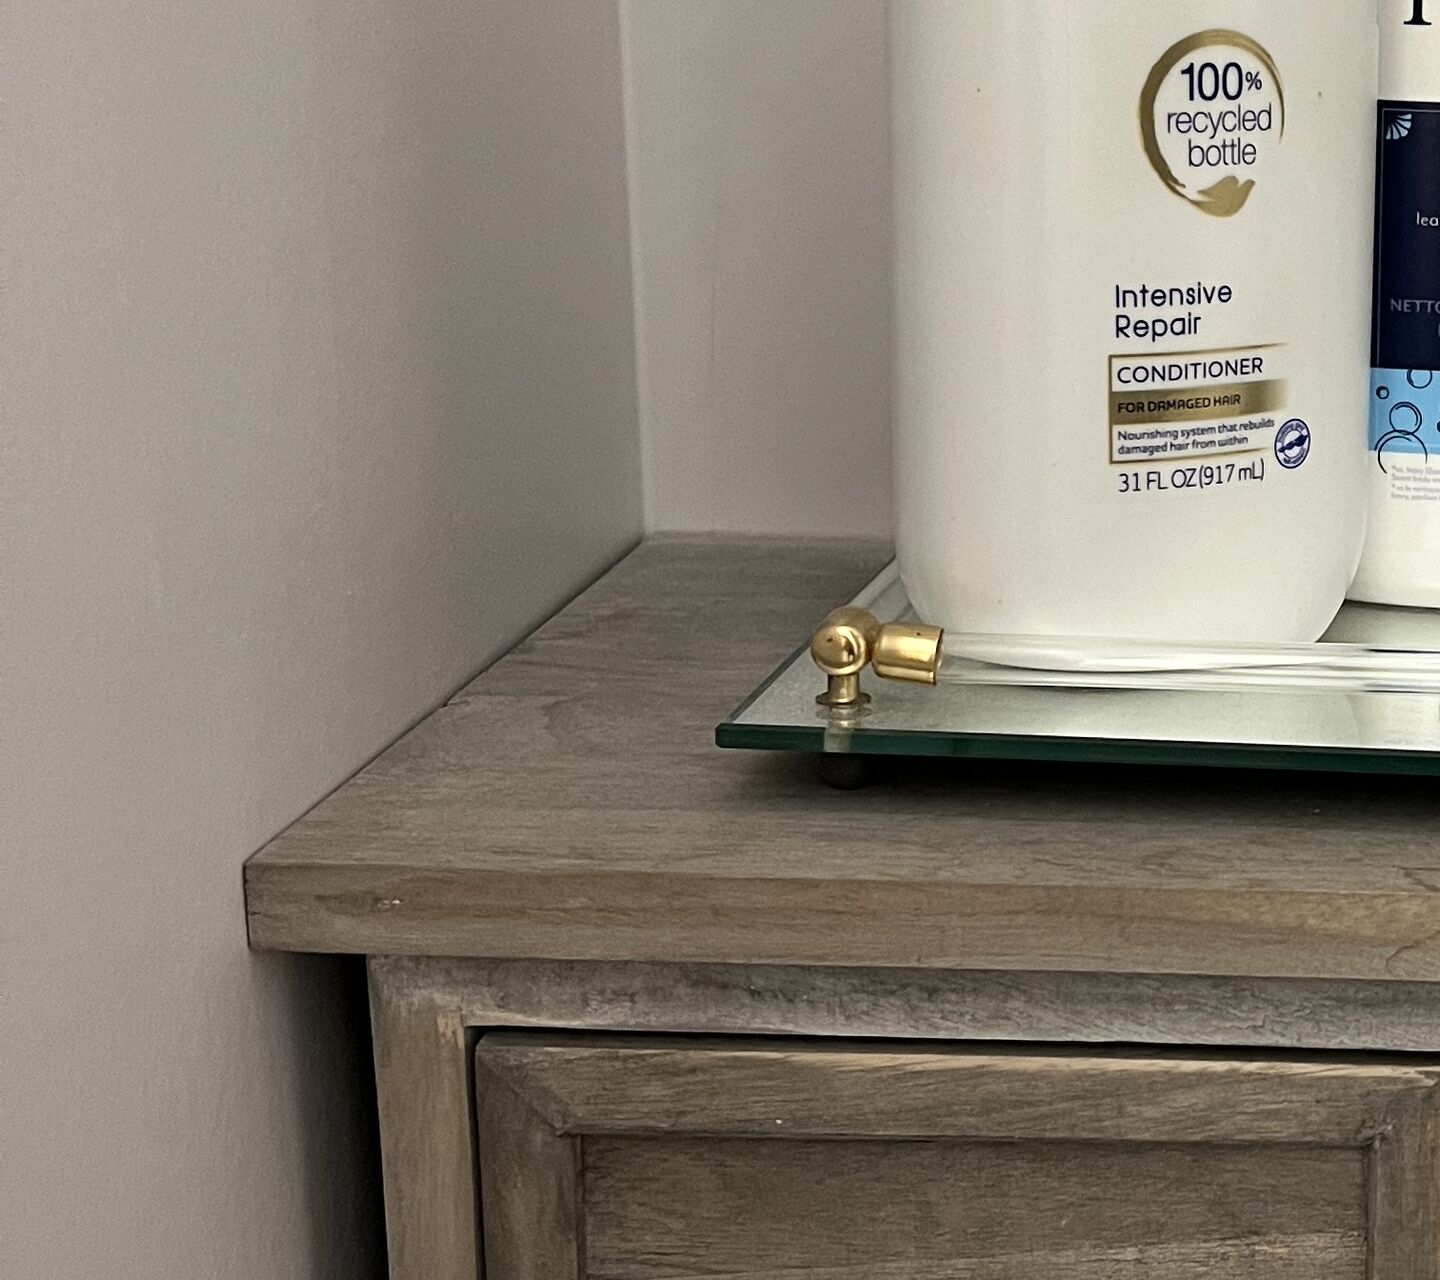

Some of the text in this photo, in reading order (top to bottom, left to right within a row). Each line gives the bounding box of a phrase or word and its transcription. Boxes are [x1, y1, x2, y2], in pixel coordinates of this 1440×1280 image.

[1181, 62, 1262, 101] 100%
[1167, 103, 1272, 139] recycled
[1188, 137, 1257, 167] bottle
[1115, 282, 1232, 308] Intensive
[1115, 312, 1201, 342] Repair
[1117, 357, 1263, 383] CONDITIONER
[1117, 394, 1241, 413] FOR DAMAGED HAIR
[1117, 418, 1275, 441] Nourishing system that rebuilds
[1117, 436, 1248, 456] damaged hair from within
[1118, 472, 1141, 493] 31
[1146, 471, 1168, 491] FL
[1171, 468, 1197, 488] OZ
